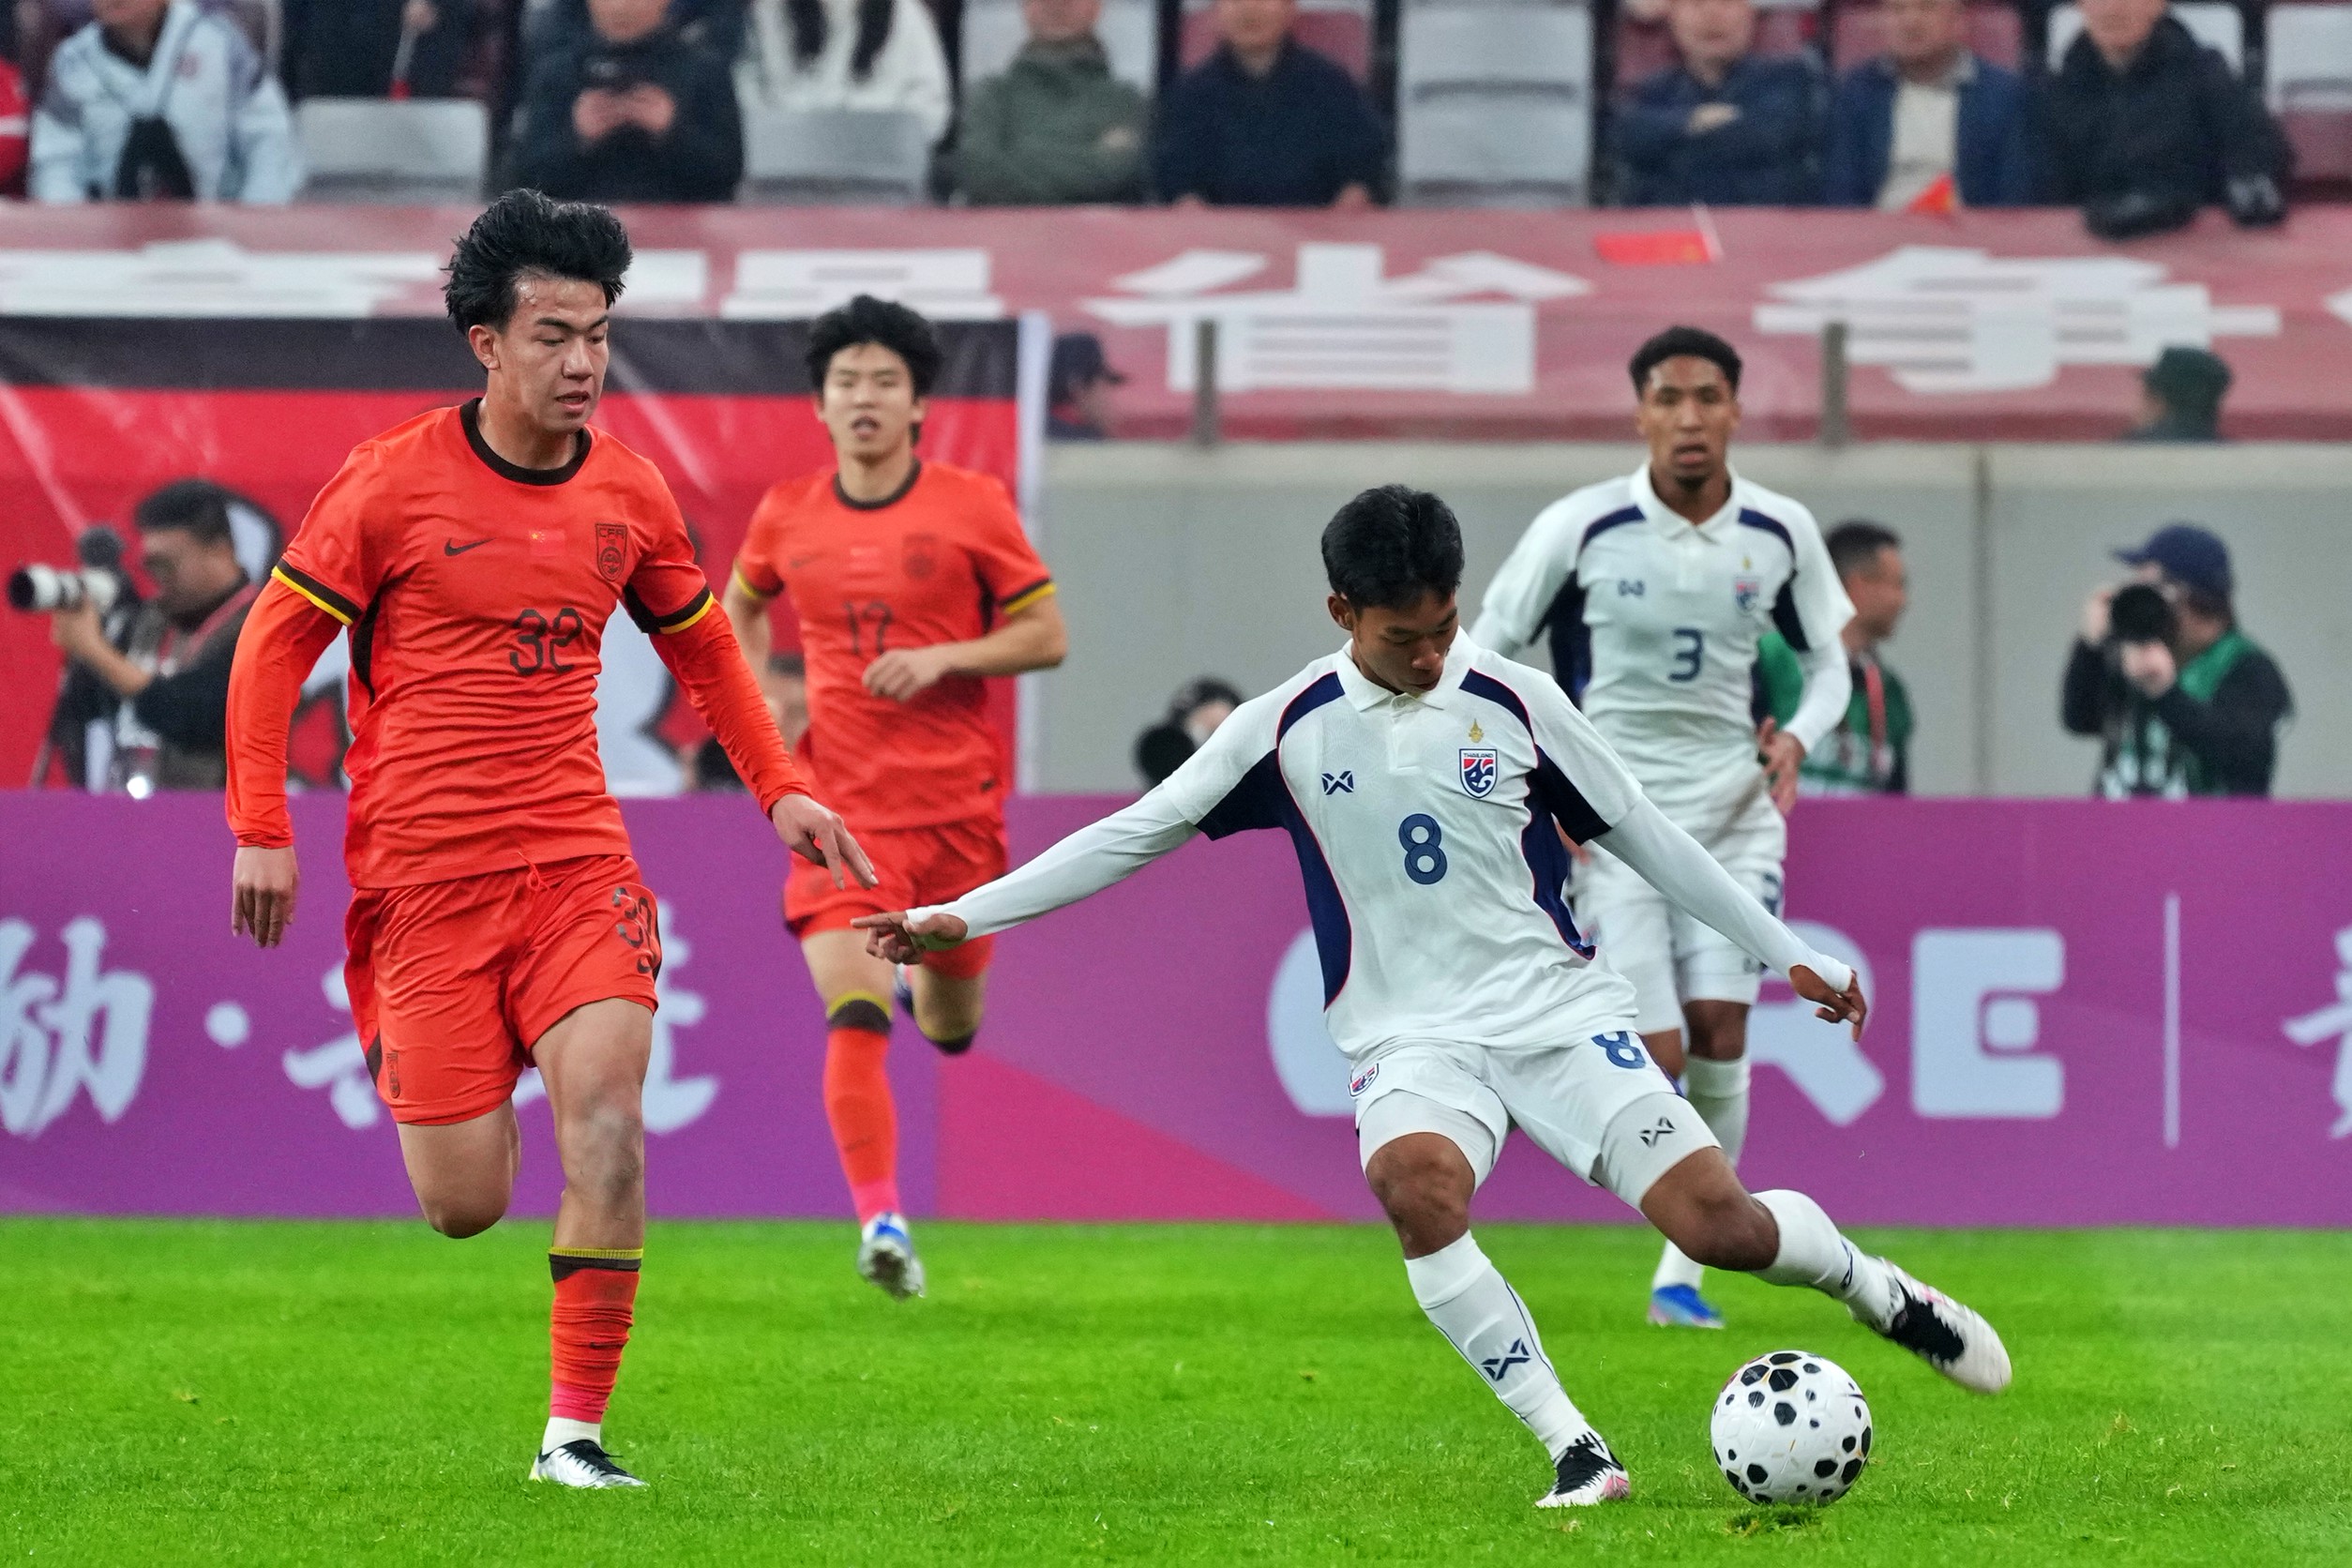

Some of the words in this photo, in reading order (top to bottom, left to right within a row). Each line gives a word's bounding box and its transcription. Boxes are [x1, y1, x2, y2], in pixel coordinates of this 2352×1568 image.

[509, 607, 583, 675] 32
[842, 600, 893, 656] 17
[1667, 627, 1703, 683] 3
[1398, 813, 1447, 885] 8
[1591, 1031, 1646, 1069] 8
